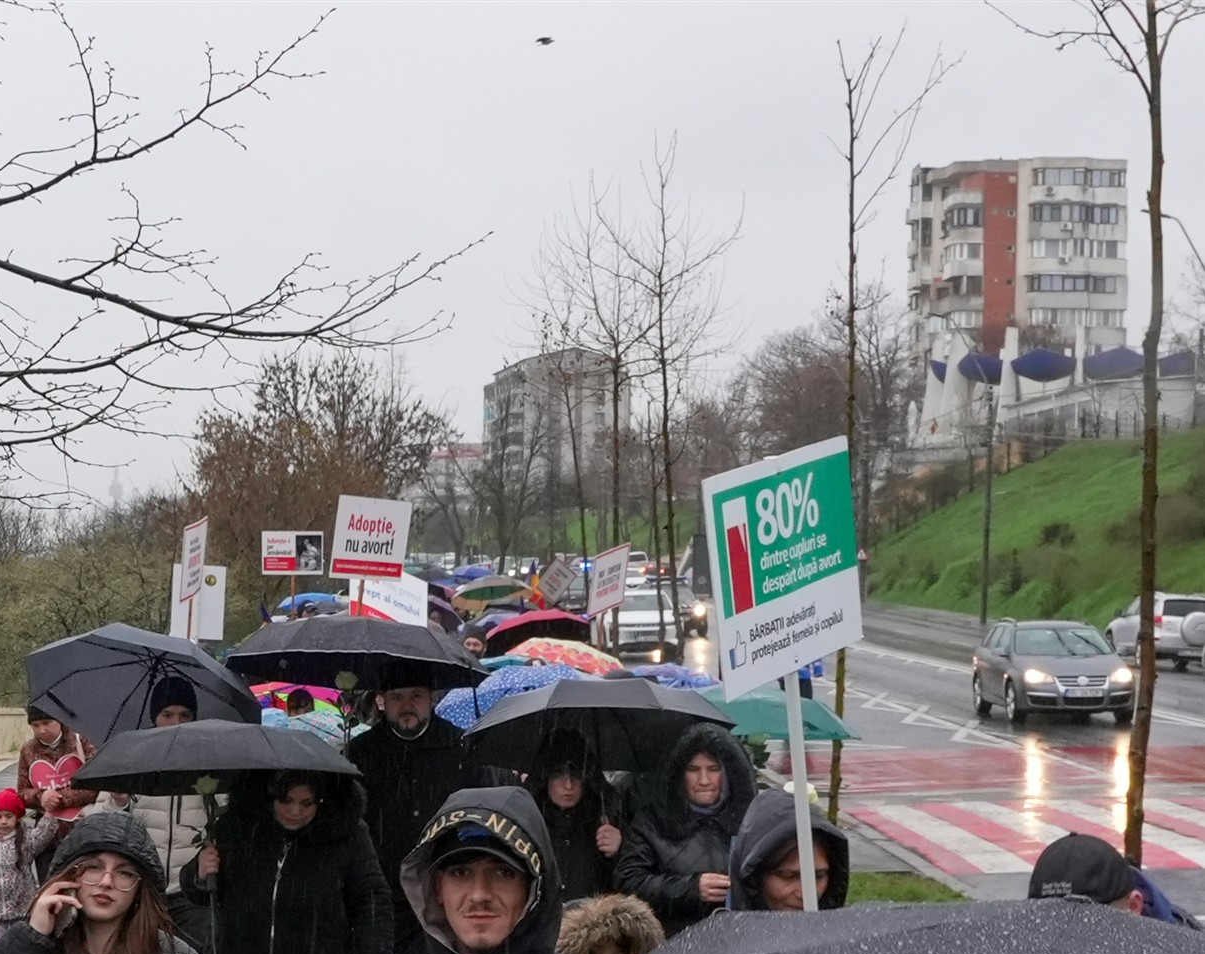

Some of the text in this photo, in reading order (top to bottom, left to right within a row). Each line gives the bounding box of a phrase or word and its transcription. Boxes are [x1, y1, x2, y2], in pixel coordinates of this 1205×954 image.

[347, 514, 396, 538] Adopție,
[755, 472, 819, 546] 80%
[345, 538, 394, 556] nu avort!
[760, 534, 827, 570] dintre cupluri se
[763, 550, 841, 594] despart după avort
[357, 584, 381, 600] ept
[383, 592, 391, 603] al
[393, 600, 421, 616] omului
[749, 602, 816, 643] BĂRBAȚII adevărați
[751, 632, 791, 664] protejează
[792, 624, 813, 644] femeia
[815, 619, 820, 636] și
